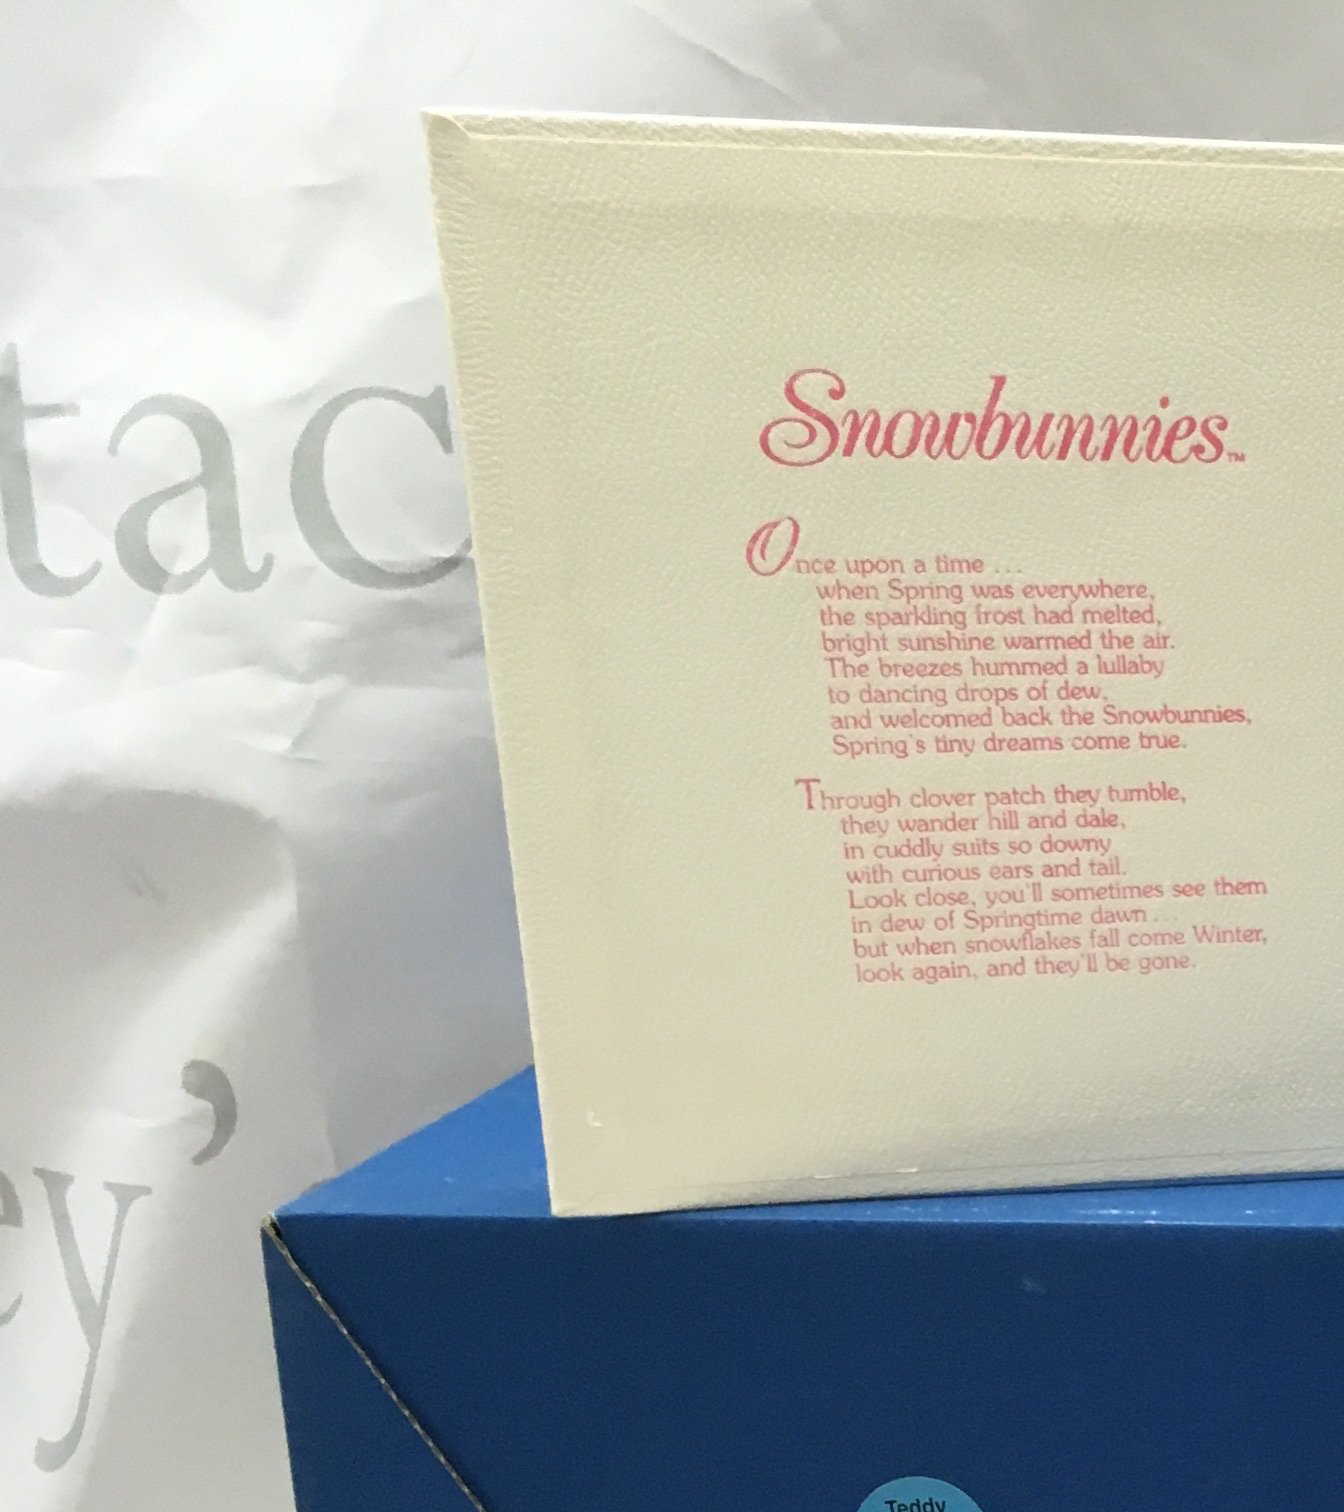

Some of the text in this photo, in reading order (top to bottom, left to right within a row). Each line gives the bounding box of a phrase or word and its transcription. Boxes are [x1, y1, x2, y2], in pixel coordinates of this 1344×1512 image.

[759, 367, 1229, 467] Snowbunnies
[745, 516, 836, 576] Once
[846, 558, 905, 577] upon
[913, 560, 927, 574] a
[935, 555, 984, 574] time
[815, 578, 1155, 604] when Spring was everywhere,
[819, 603, 1162, 630] the sparkling frost had melted,
[822, 629, 1175, 657] bright sunshine warmed the air.
[824, 654, 1165, 679] The breezes hummed a lullaby
[828, 687, 850, 704] to
[859, 683, 948, 707] dancing
[955, 681, 1019, 706] drops
[1026, 680, 1049, 701] of
[830, 703, 1252, 730] and welcomed back the Snowbunnies,
[832, 731, 1188, 759] Spring's tiny dreams come true.
[795, 778, 1187, 814] Through clover patch they tumble,
[841, 808, 1126, 838] they wander hill and dale,
[842, 835, 1111, 862] in cuddly suits so downy
[846, 856, 1127, 885] with curious ears and tail.
[848, 876, 1268, 910] Look close, you'll sometimes see them
[851, 916, 872, 934] in
[880, 914, 926, 932] dew
[933, 910, 955, 930] of
[963, 908, 1083, 934] Springtime
[853, 924, 1268, 959] but when snowflakes fall come Winter,
[855, 961, 904, 983] look
[986, 957, 1027, 978] and
[1034, 952, 1098, 979] they'll
[1105, 953, 1131, 971] be
[1138, 954, 1197, 976] gone.
